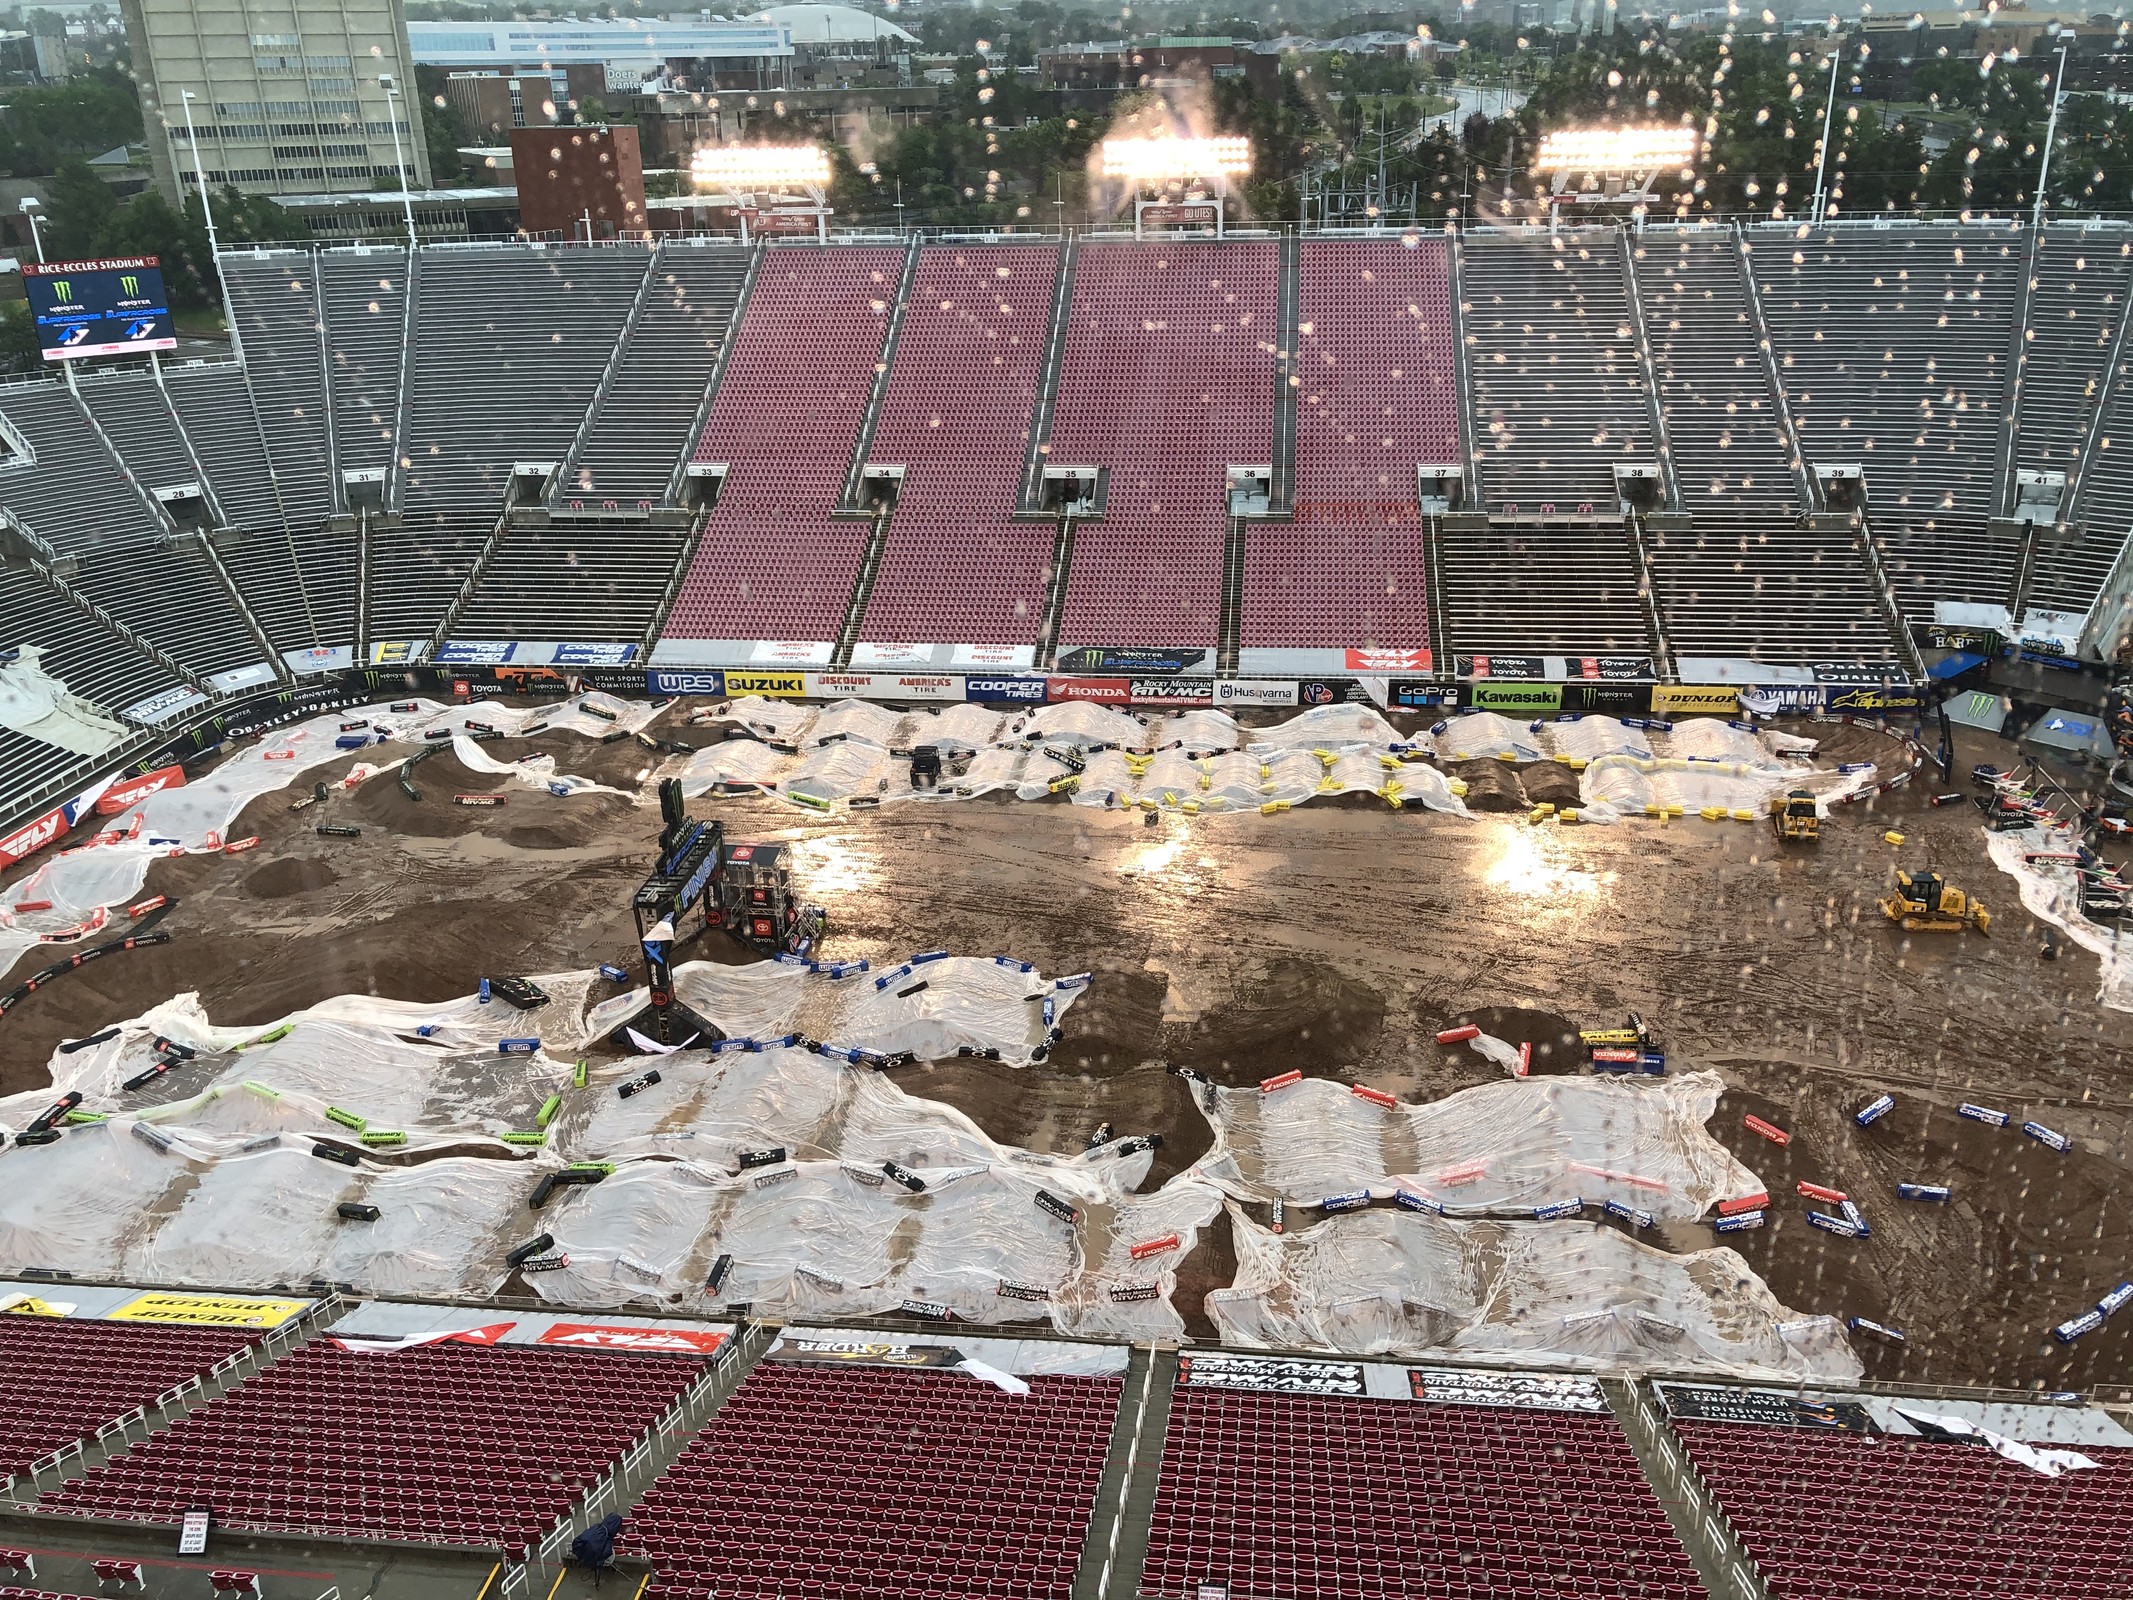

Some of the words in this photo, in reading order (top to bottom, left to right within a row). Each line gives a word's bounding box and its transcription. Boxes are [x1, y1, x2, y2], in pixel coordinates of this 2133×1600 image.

[607, 69, 637, 79] Doers
[608, 79, 647, 90] wanted
[1184, 208, 1194, 218] GO
[1195, 207, 1213, 218] UTES!
[38, 261, 97, 274] RICE-ECCLES
[100, 259, 144, 270] STADIUM
[528, 467, 540, 475] 32
[701, 468, 712, 476] 33
[878, 469, 890, 477] 34
[1065, 470, 1077, 478] 35
[1244, 470, 1255, 478] 36
[1435, 469, 1447, 477] 37
[1631, 469, 1643, 477] 38
[1832, 469, 1844, 477] 39
[358, 473, 369, 481] 31
[2034, 477, 2047, 485] 41
[172, 491, 185, 499] 28
[448, 642, 511, 650] COOPER
[1602, 669, 1638, 677] TOYOTA
[658, 673, 715, 693] WPS
[727, 678, 803, 691] SUZUKI
[818, 676, 871, 685] DISCOUNT
[899, 677, 952, 687] AMERICA'S
[968, 681, 1045, 691] COOPER
[293, 687, 340, 701] MONSTER
[1005, 690, 1043, 698] TIRES
[1068, 688, 1127, 697] HONDA
[1234, 687, 1292, 699] Husqvarna
[1399, 686, 1458, 696] GoPro
[1476, 690, 1557, 703] Kawasaki
[1131, 696, 1212, 704] RockyMountainATVMC.com
[1667, 694, 1737, 703] DUNLOP
[1768, 691, 1827, 705] YAMAHA
[309, 696, 370, 712] OAKLEY
[150, 751, 174, 768] MONSTER
[110, 776, 167, 803] FLY
[1, 813, 60, 856] FLY
[680, 848, 718, 910] FINISH
[135, 938, 157, 946] TOYOTA
[1273, 1076, 1302, 1090] HONDA
[1362, 1094, 1393, 1108] HONDA
[1959, 1107, 2004, 1124] COOPER
[1744, 1118, 1777, 1140] HONDA
[1326, 1197, 1370, 1211] COOPER
[1536, 1197, 1579, 1212] COOPER
[1538, 1204, 1583, 1220] COOPER
[1716, 1211, 1762, 1224] COOPER
[1719, 1218, 1764, 1232] COOPER
[1143, 1243, 1178, 1257] HONDA
[145, 1299, 262, 1311] DUNLOP
[130, 1311, 240, 1322] DUNLOP
[553, 1332, 701, 1350] FLY
[1191, 1363, 1274, 1375] MOUNTAIN
[1280, 1369, 1333, 1379] ROCKY
[1190, 1378, 1275, 1389] MOUNTAIN
[1280, 1383, 1333, 1393] ROCKY
[1423, 1378, 1511, 1390] MOUNTAIN
[1426, 1392, 1515, 1405] MOUNTAIN
[1517, 1398, 1574, 1409] ROCKY
[1694, 1395, 1747, 1405] SPORTS
[1751, 1397, 1789, 1407] UTAH
[1699, 1405, 1796, 1418] COMMISSION
[1701, 1411, 1755, 1421] SPORTS
